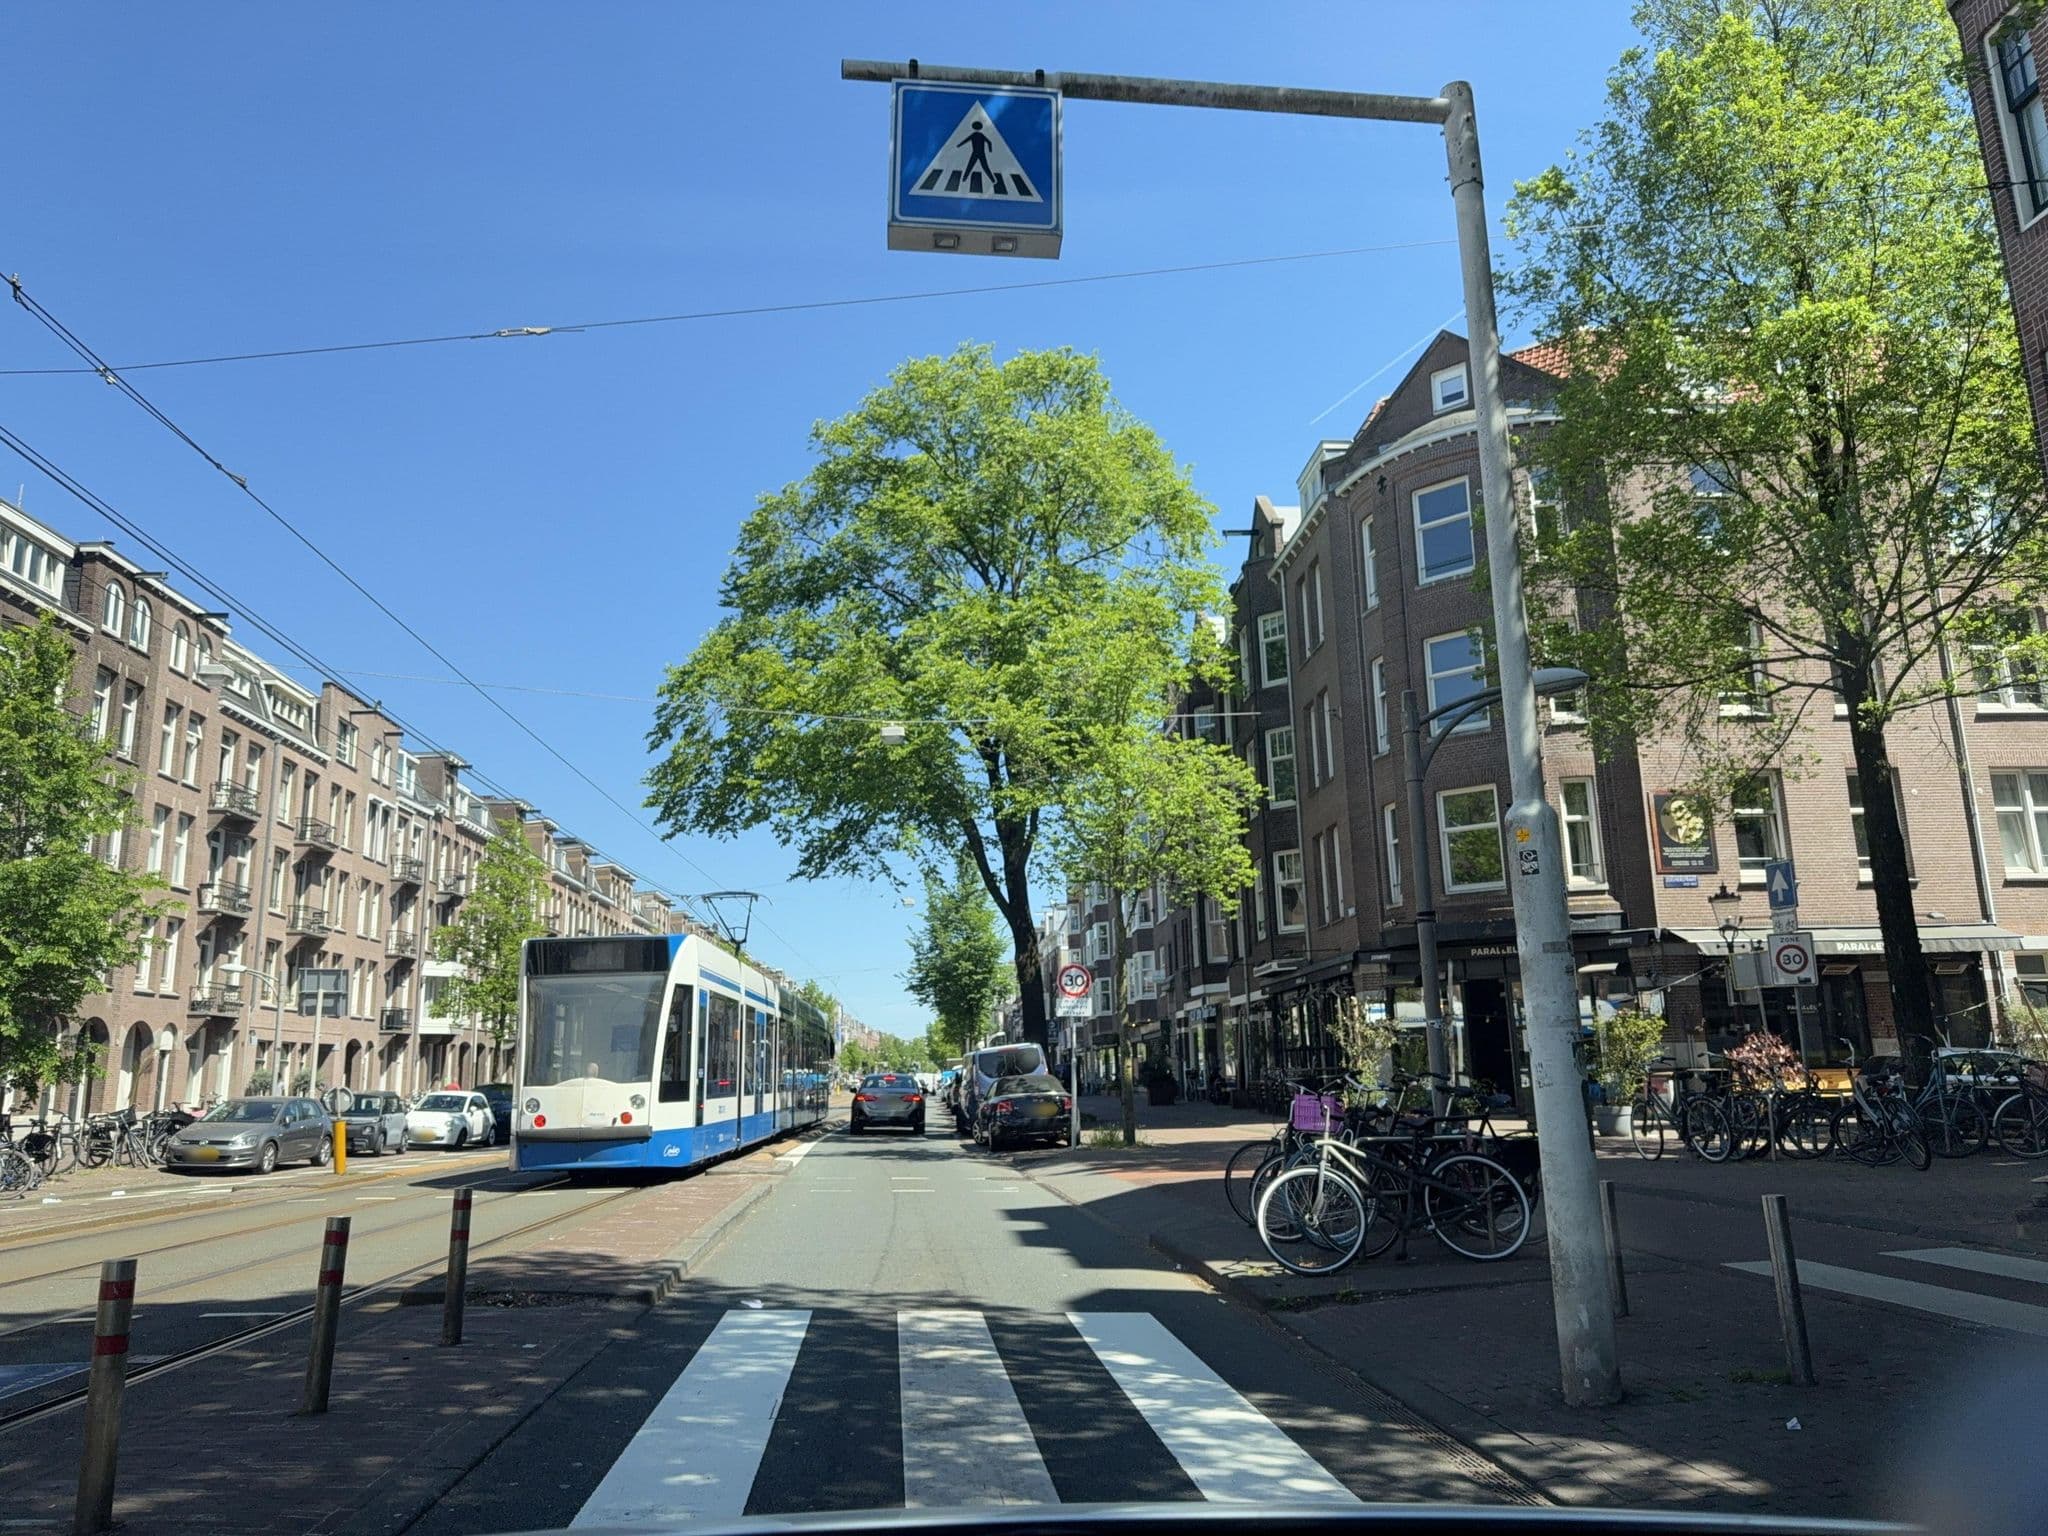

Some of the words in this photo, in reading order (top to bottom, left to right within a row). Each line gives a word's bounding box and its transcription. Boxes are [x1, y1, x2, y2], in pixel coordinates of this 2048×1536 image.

[1836, 942, 1884, 951] PARALLE
[1782, 953, 1802, 965] 30
[1064, 974, 1085, 987] 30
